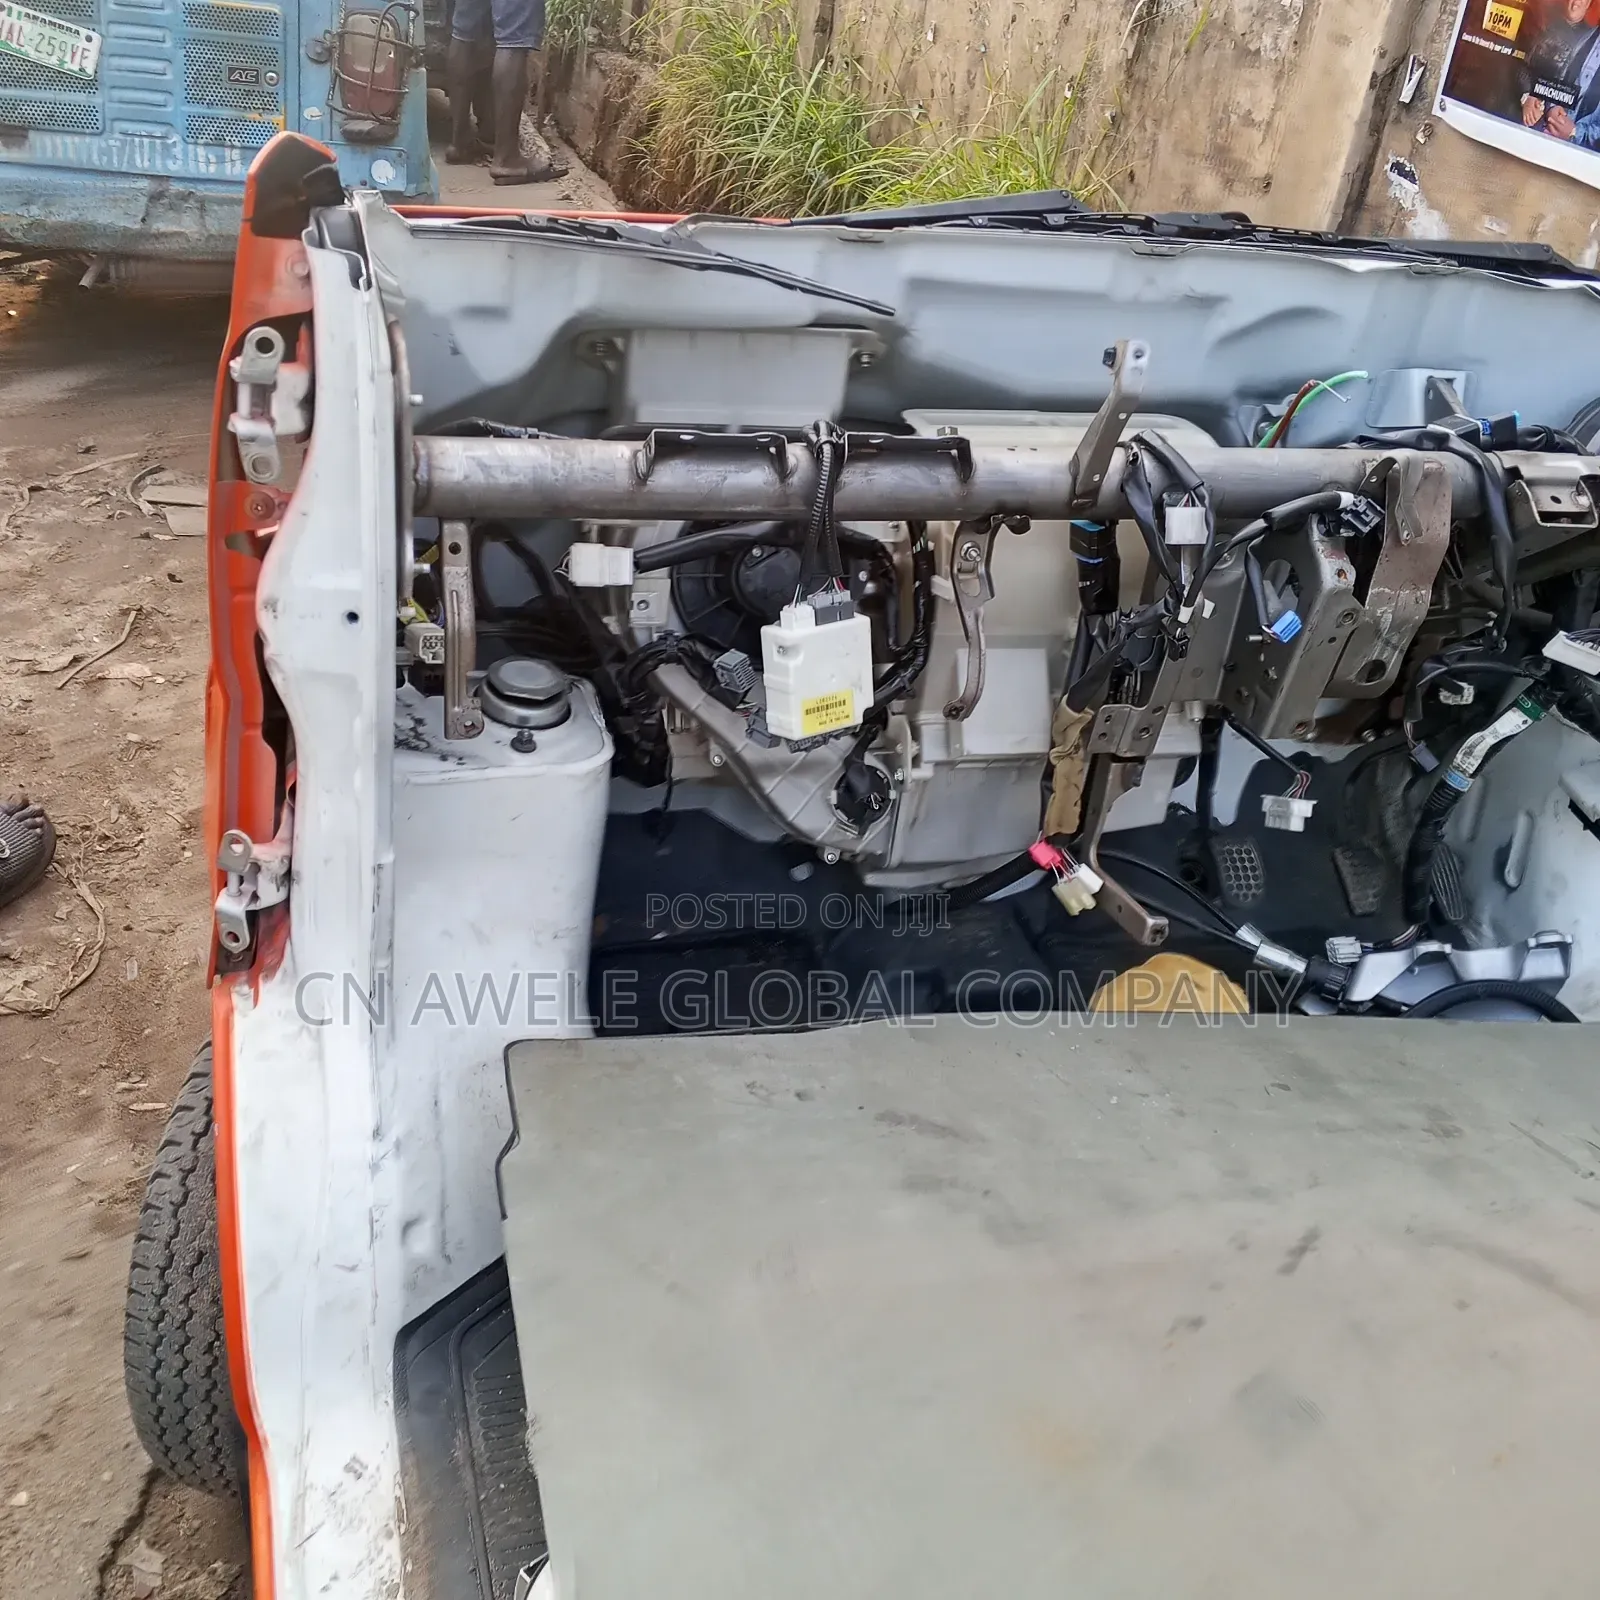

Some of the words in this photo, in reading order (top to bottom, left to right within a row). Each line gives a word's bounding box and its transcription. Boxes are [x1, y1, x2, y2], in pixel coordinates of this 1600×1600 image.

[24, 12, 80, 36] ANAMBRA
[1488, 12, 1512, 29] 10PM
[230, 69, 257, 82] AC
[1533, 83, 1575, 105] NWACHUKWU
